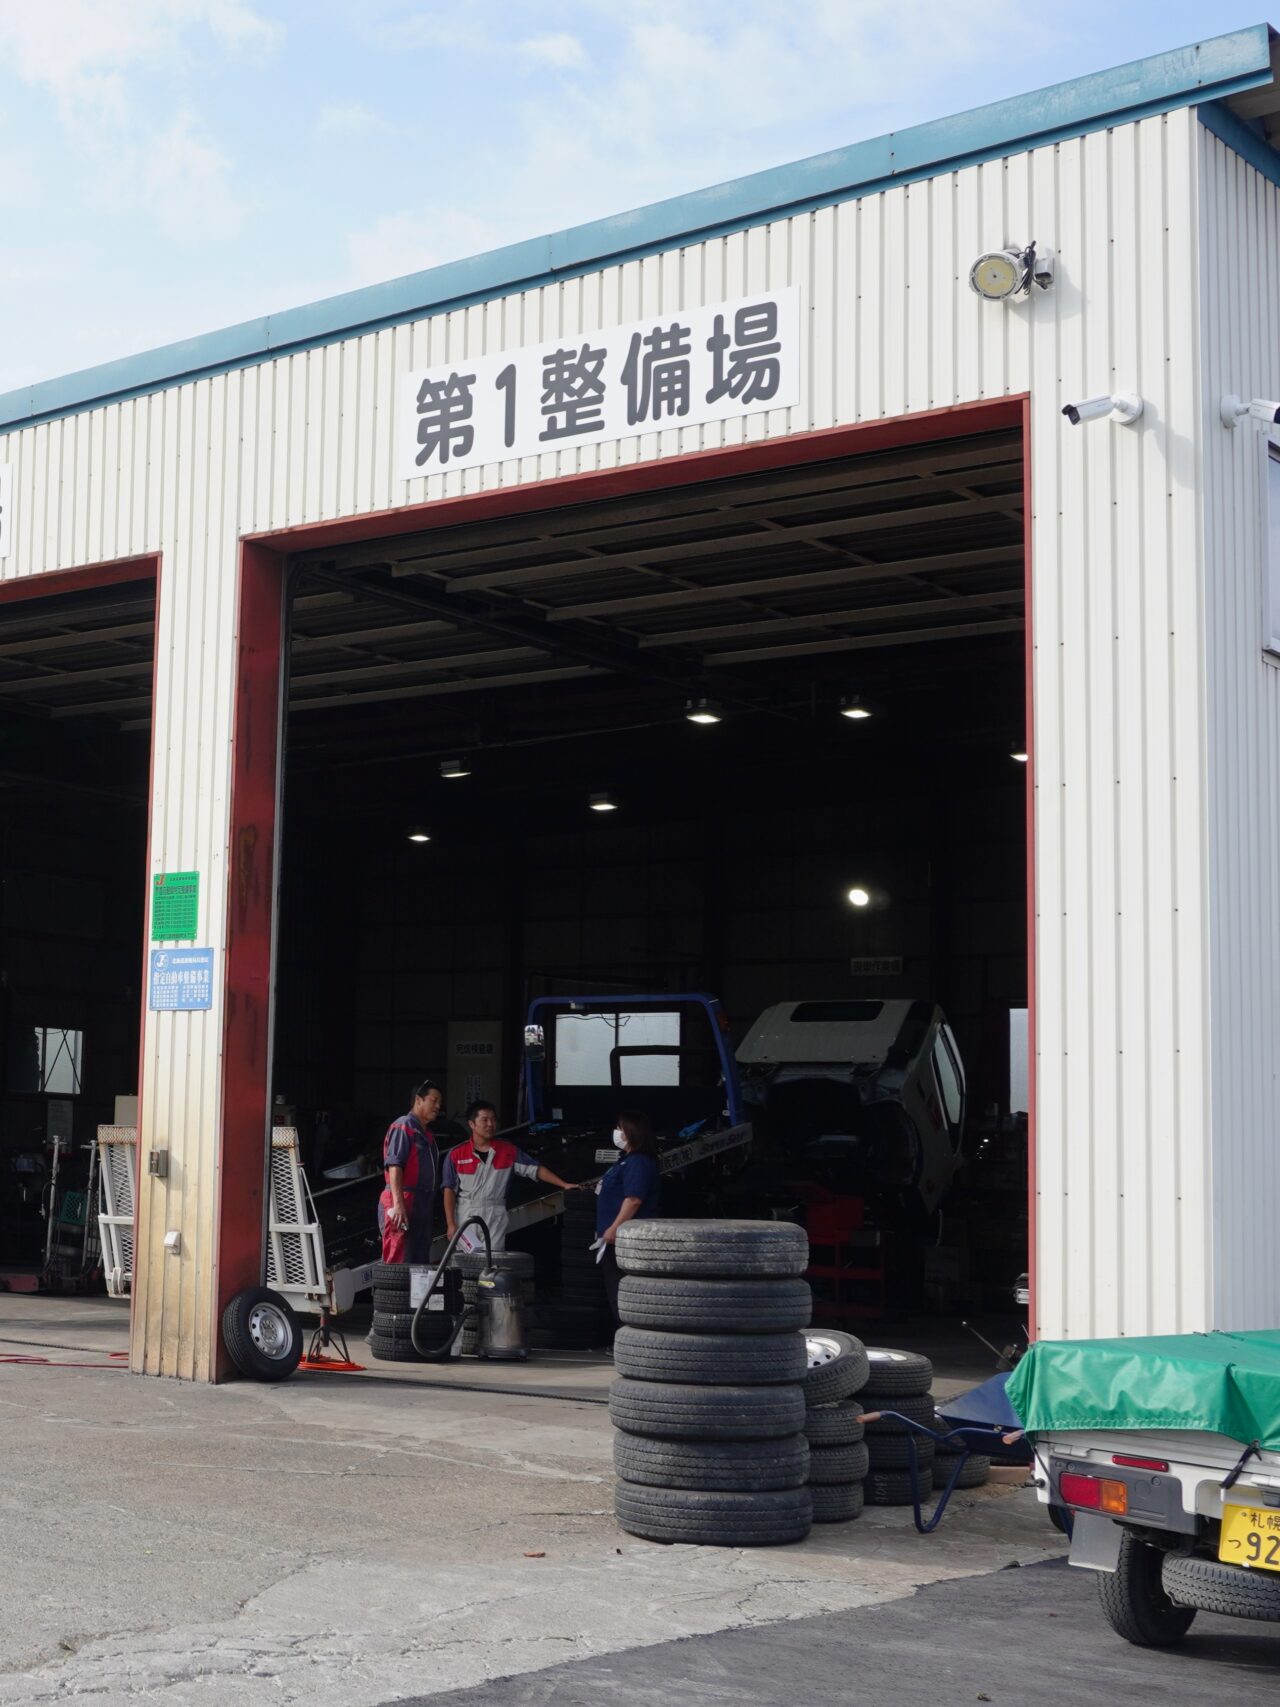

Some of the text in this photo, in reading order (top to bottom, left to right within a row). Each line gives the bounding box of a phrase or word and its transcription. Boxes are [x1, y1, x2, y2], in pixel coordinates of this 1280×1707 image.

[415, 302, 781, 467] 第1整備場
[1228, 1539, 1242, 1549] つ
